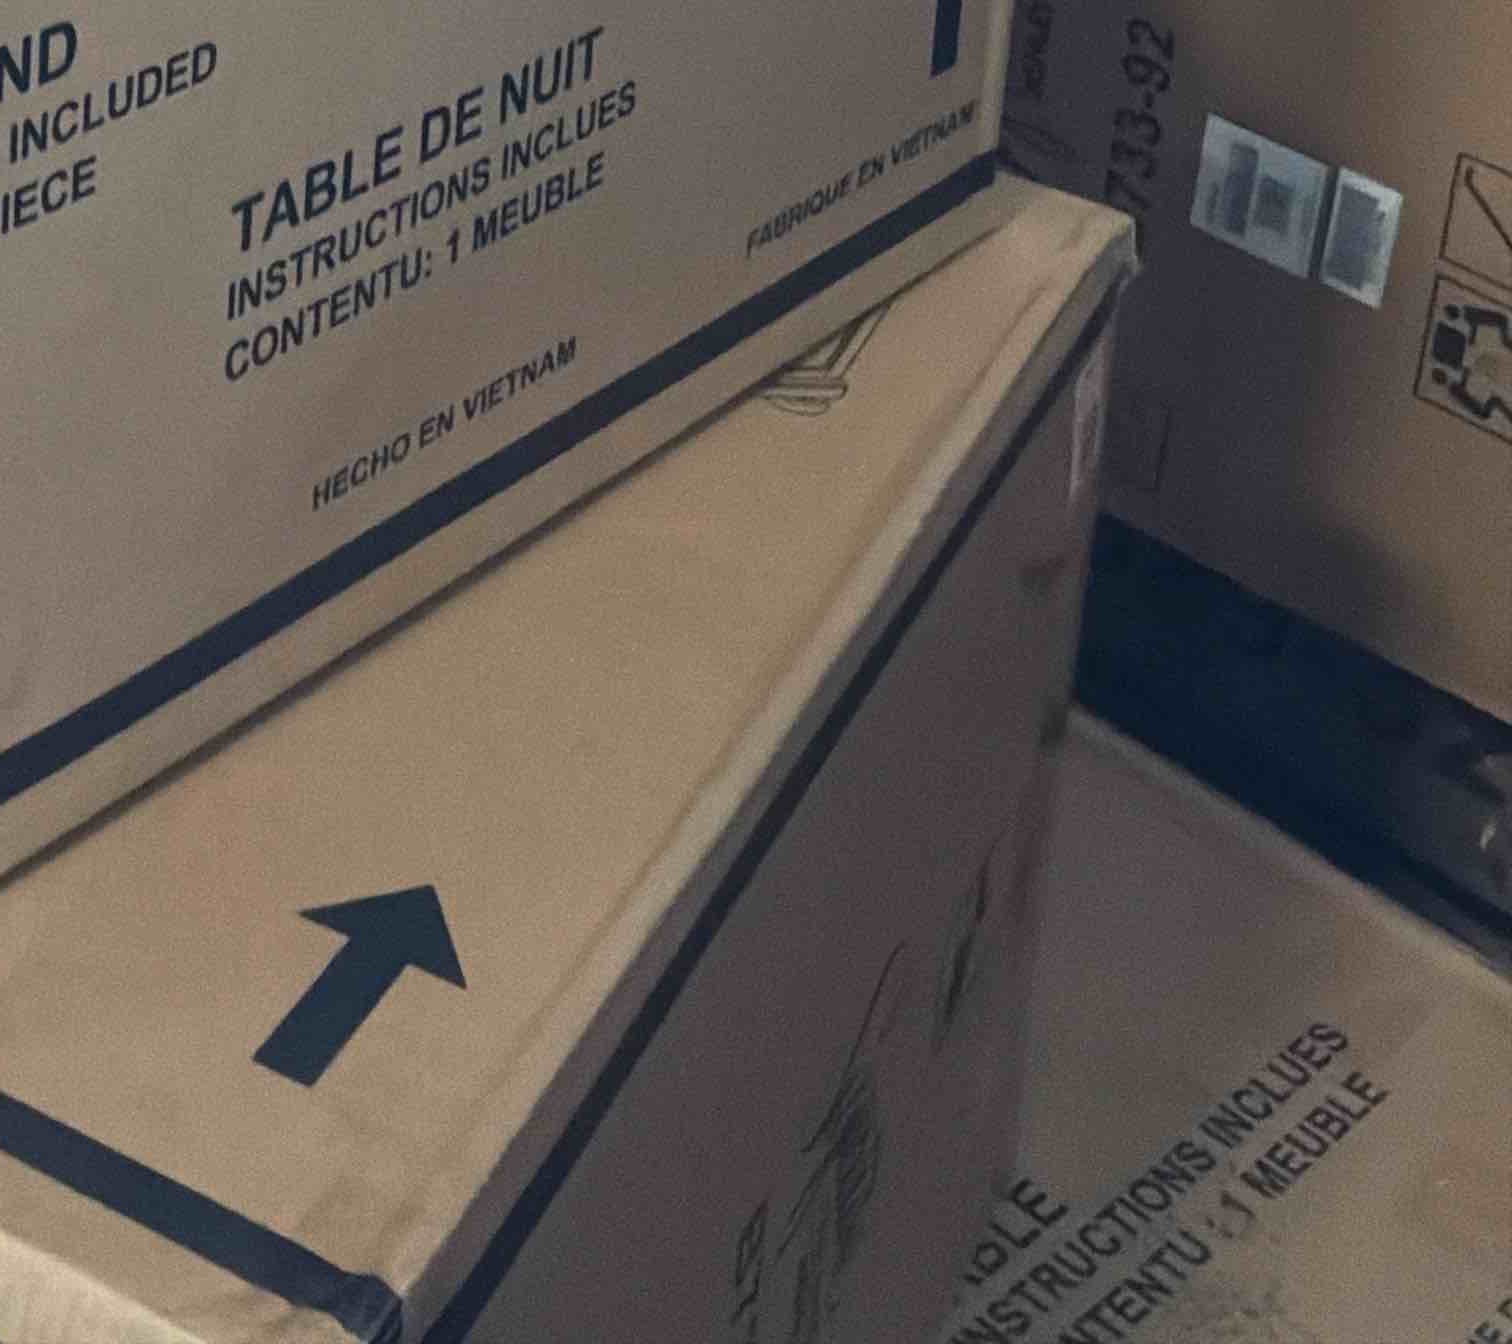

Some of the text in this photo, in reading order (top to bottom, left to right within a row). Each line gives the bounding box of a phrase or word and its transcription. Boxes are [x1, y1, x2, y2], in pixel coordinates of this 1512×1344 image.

[9, 40, 218, 165] INCLUDED
[226, 79, 638, 321] INSTRUCTIONS INCLUES
[231, 26, 604, 253] TABLE DE NUIT
[856, 152, 887, 189] EN
[1103, 16, 1177, 211] 733-92
[224, 151, 605, 382] CONTENTU: 1 MEUBLE
[311, 334, 577, 512] HECHO EN VIETNAM
[951, 1139, 1217, 1344] NSTRUCTIONS
[1199, 1022, 1350, 1150] INCLUES
[1240, 1070, 1388, 1201] MEUBLE
